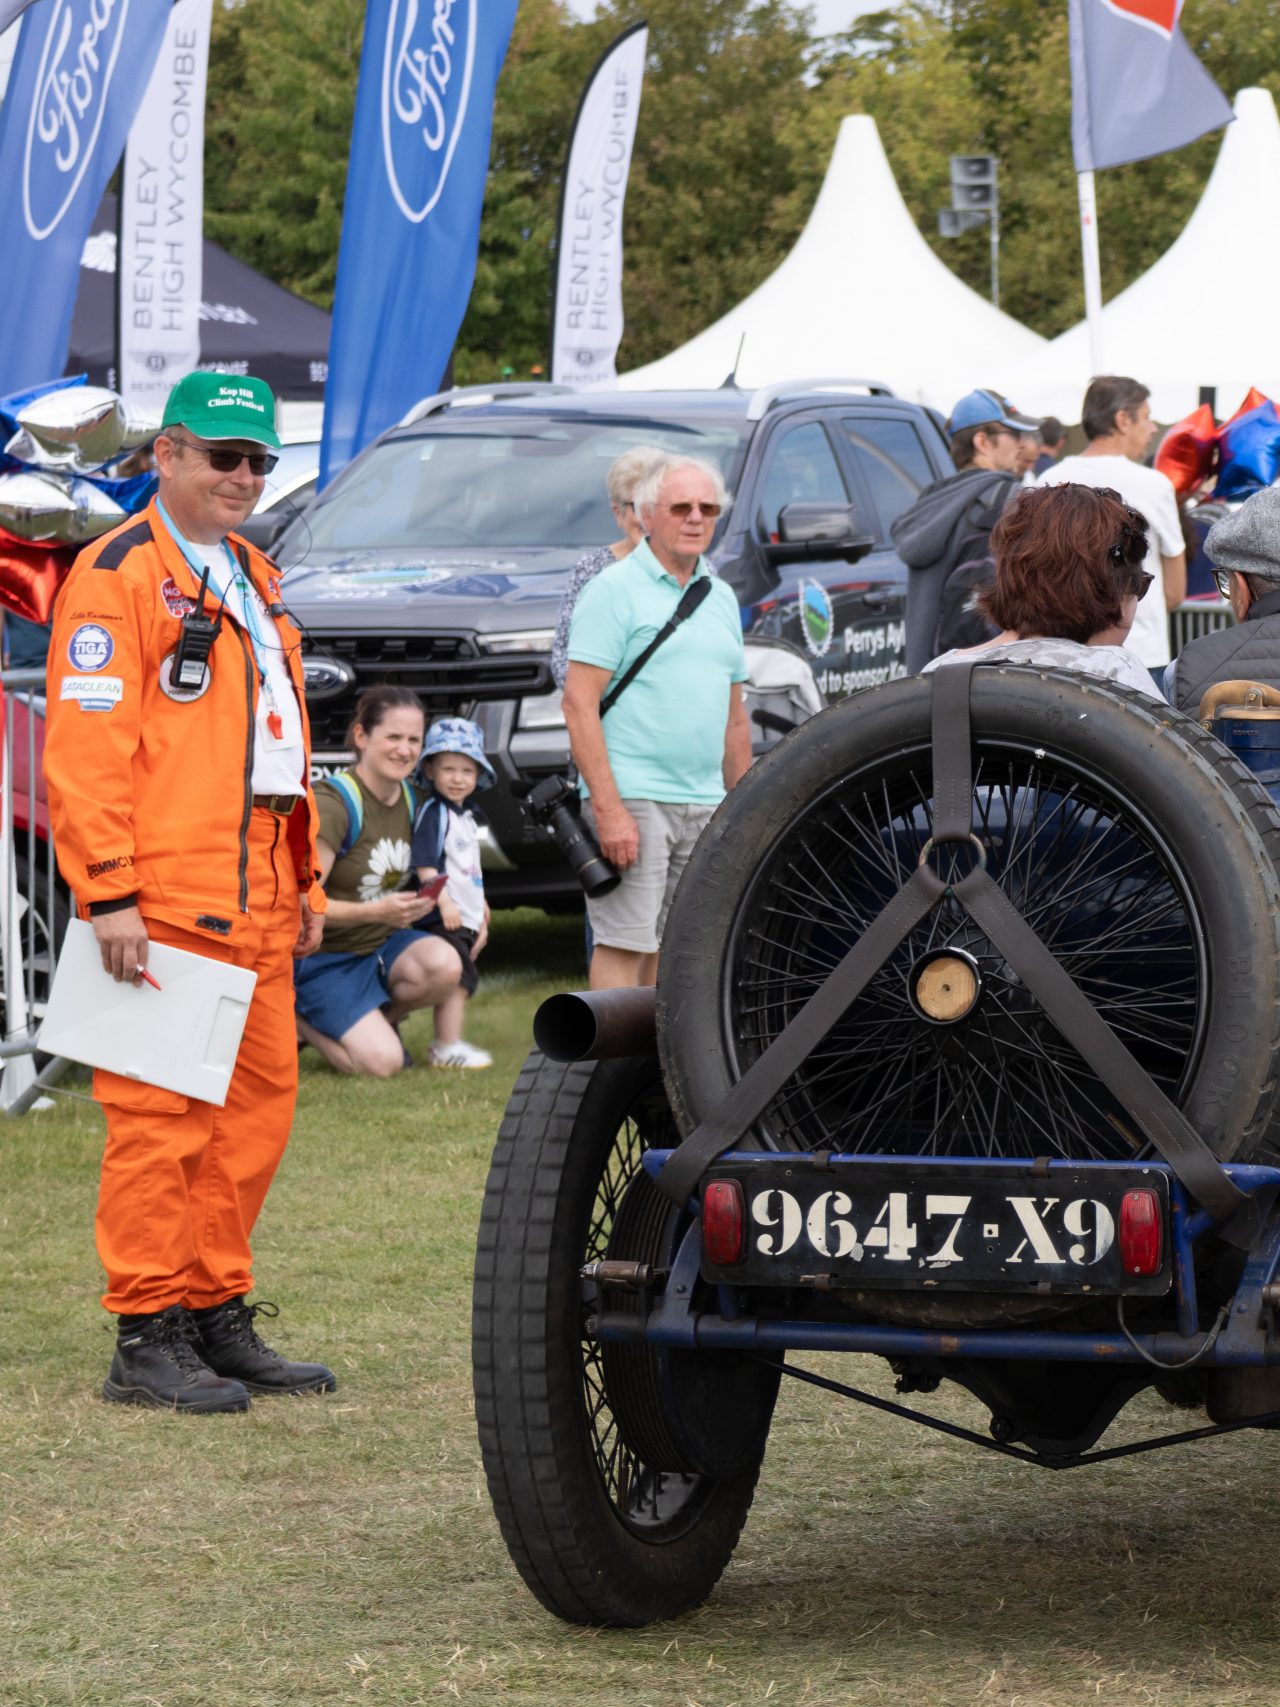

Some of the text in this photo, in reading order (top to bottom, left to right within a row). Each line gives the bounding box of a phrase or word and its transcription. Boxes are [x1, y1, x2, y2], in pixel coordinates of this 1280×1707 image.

[393, 0, 455, 150] For
[162, 28, 197, 331] HIGH WYCOMBE
[590, 67, 630, 330] HIGH WYCOMBE
[133, 157, 158, 329] BENTLEY
[567, 178, 595, 329] BENTLEY
[207, 397, 265, 412] Climb Festival
[219, 386, 253, 399] Kop Hill
[164, 586, 181, 596] NG
[74, 642, 108, 655] TIGA
[844, 626, 886, 657] Perrys
